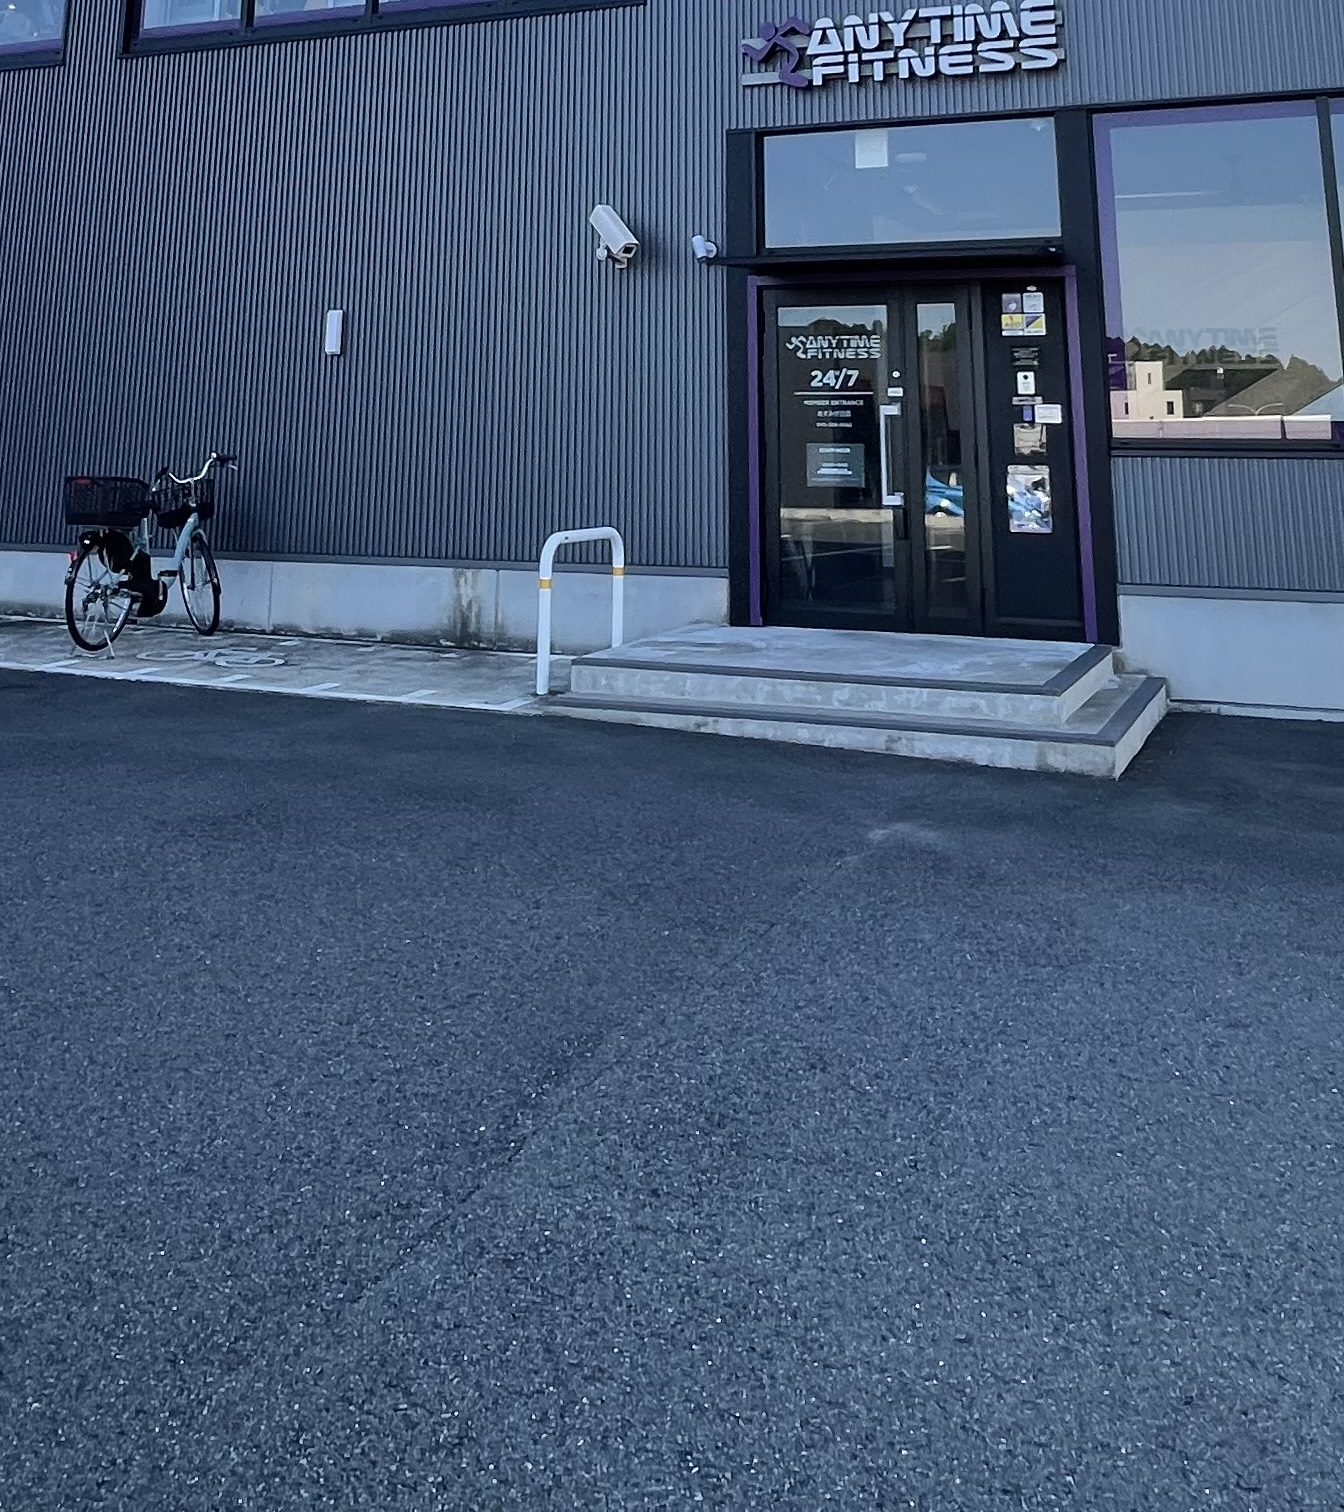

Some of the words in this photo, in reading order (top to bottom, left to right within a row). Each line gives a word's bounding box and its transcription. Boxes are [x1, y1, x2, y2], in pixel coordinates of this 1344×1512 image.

[812, 37, 1058, 86] FITNESS
[806, 335, 881, 348] ANYTIME
[807, 348, 881, 359] FITNESS
[810, 368, 859, 389] 24/7
